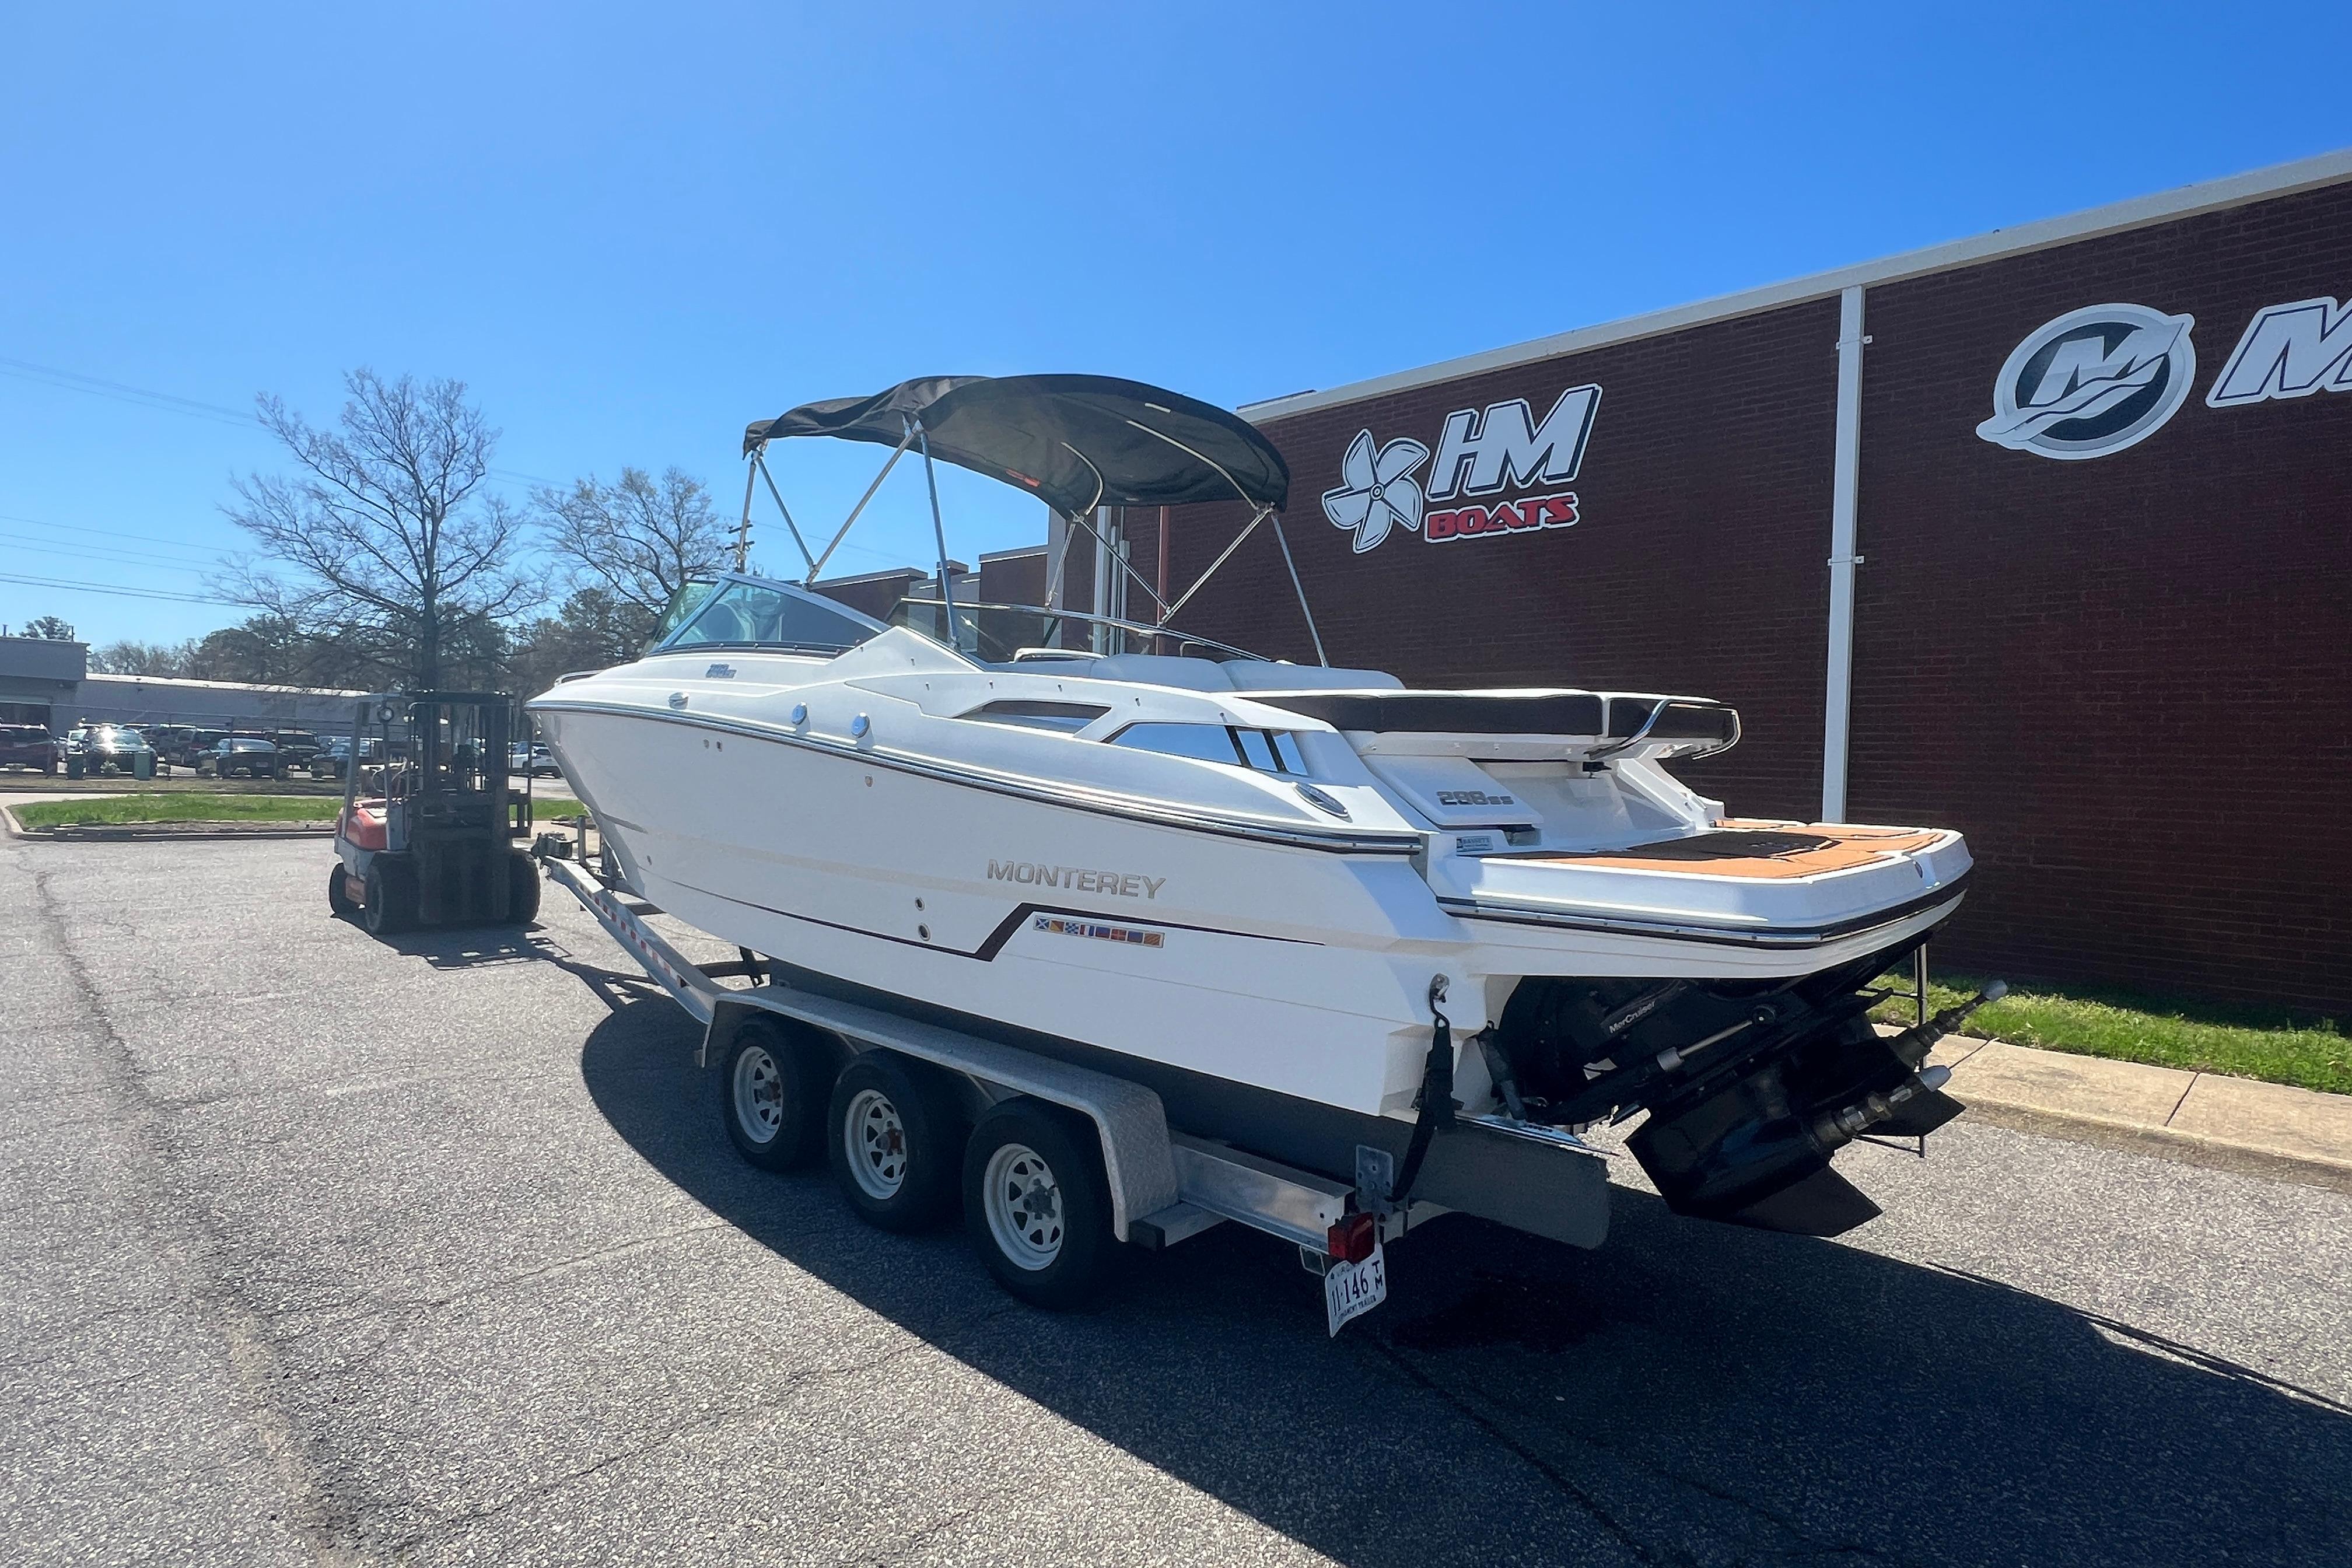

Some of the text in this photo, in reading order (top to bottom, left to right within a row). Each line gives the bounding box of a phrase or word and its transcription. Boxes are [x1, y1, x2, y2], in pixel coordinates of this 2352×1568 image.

[1427, 383, 1603, 501] HM
[1426, 494, 1578, 541] BOATS
[987, 859, 1166, 899] MONTEREY
[1609, 1000, 1656, 1034] MerCruiser
